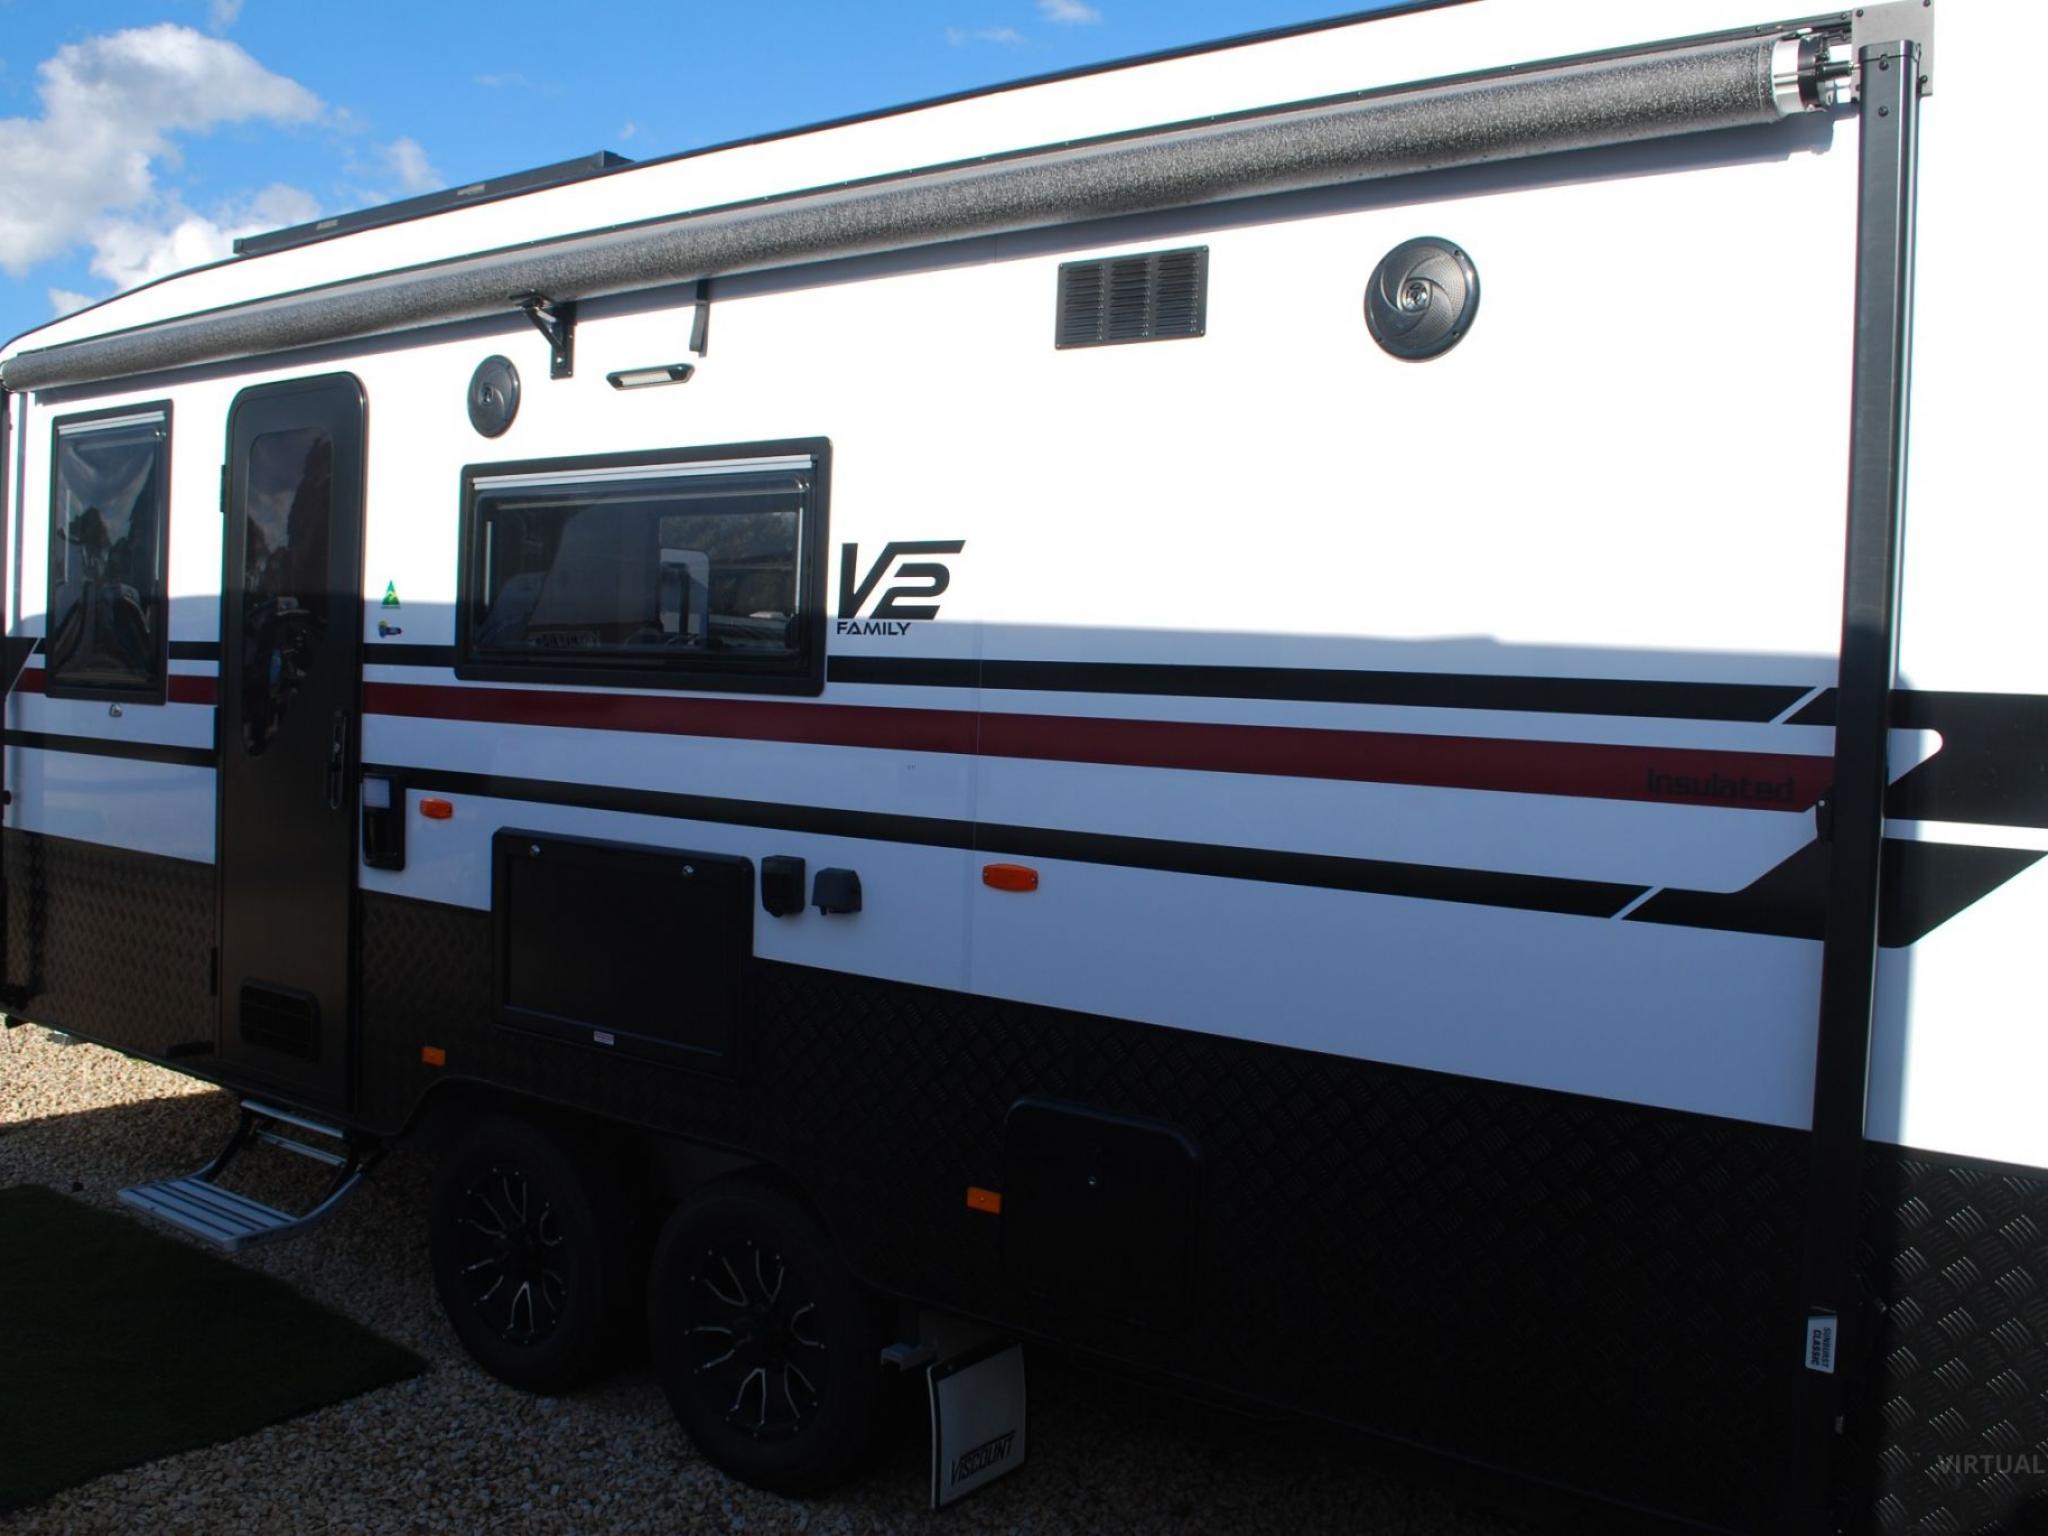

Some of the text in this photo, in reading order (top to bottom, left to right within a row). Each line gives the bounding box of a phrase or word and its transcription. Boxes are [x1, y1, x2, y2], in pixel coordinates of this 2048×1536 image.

[838, 540, 966, 620] V2
[836, 622, 911, 636] FAMILY
[1811, 1329, 1821, 1365] CLASSIC
[950, 1429, 1017, 1487] VISCOUNT
